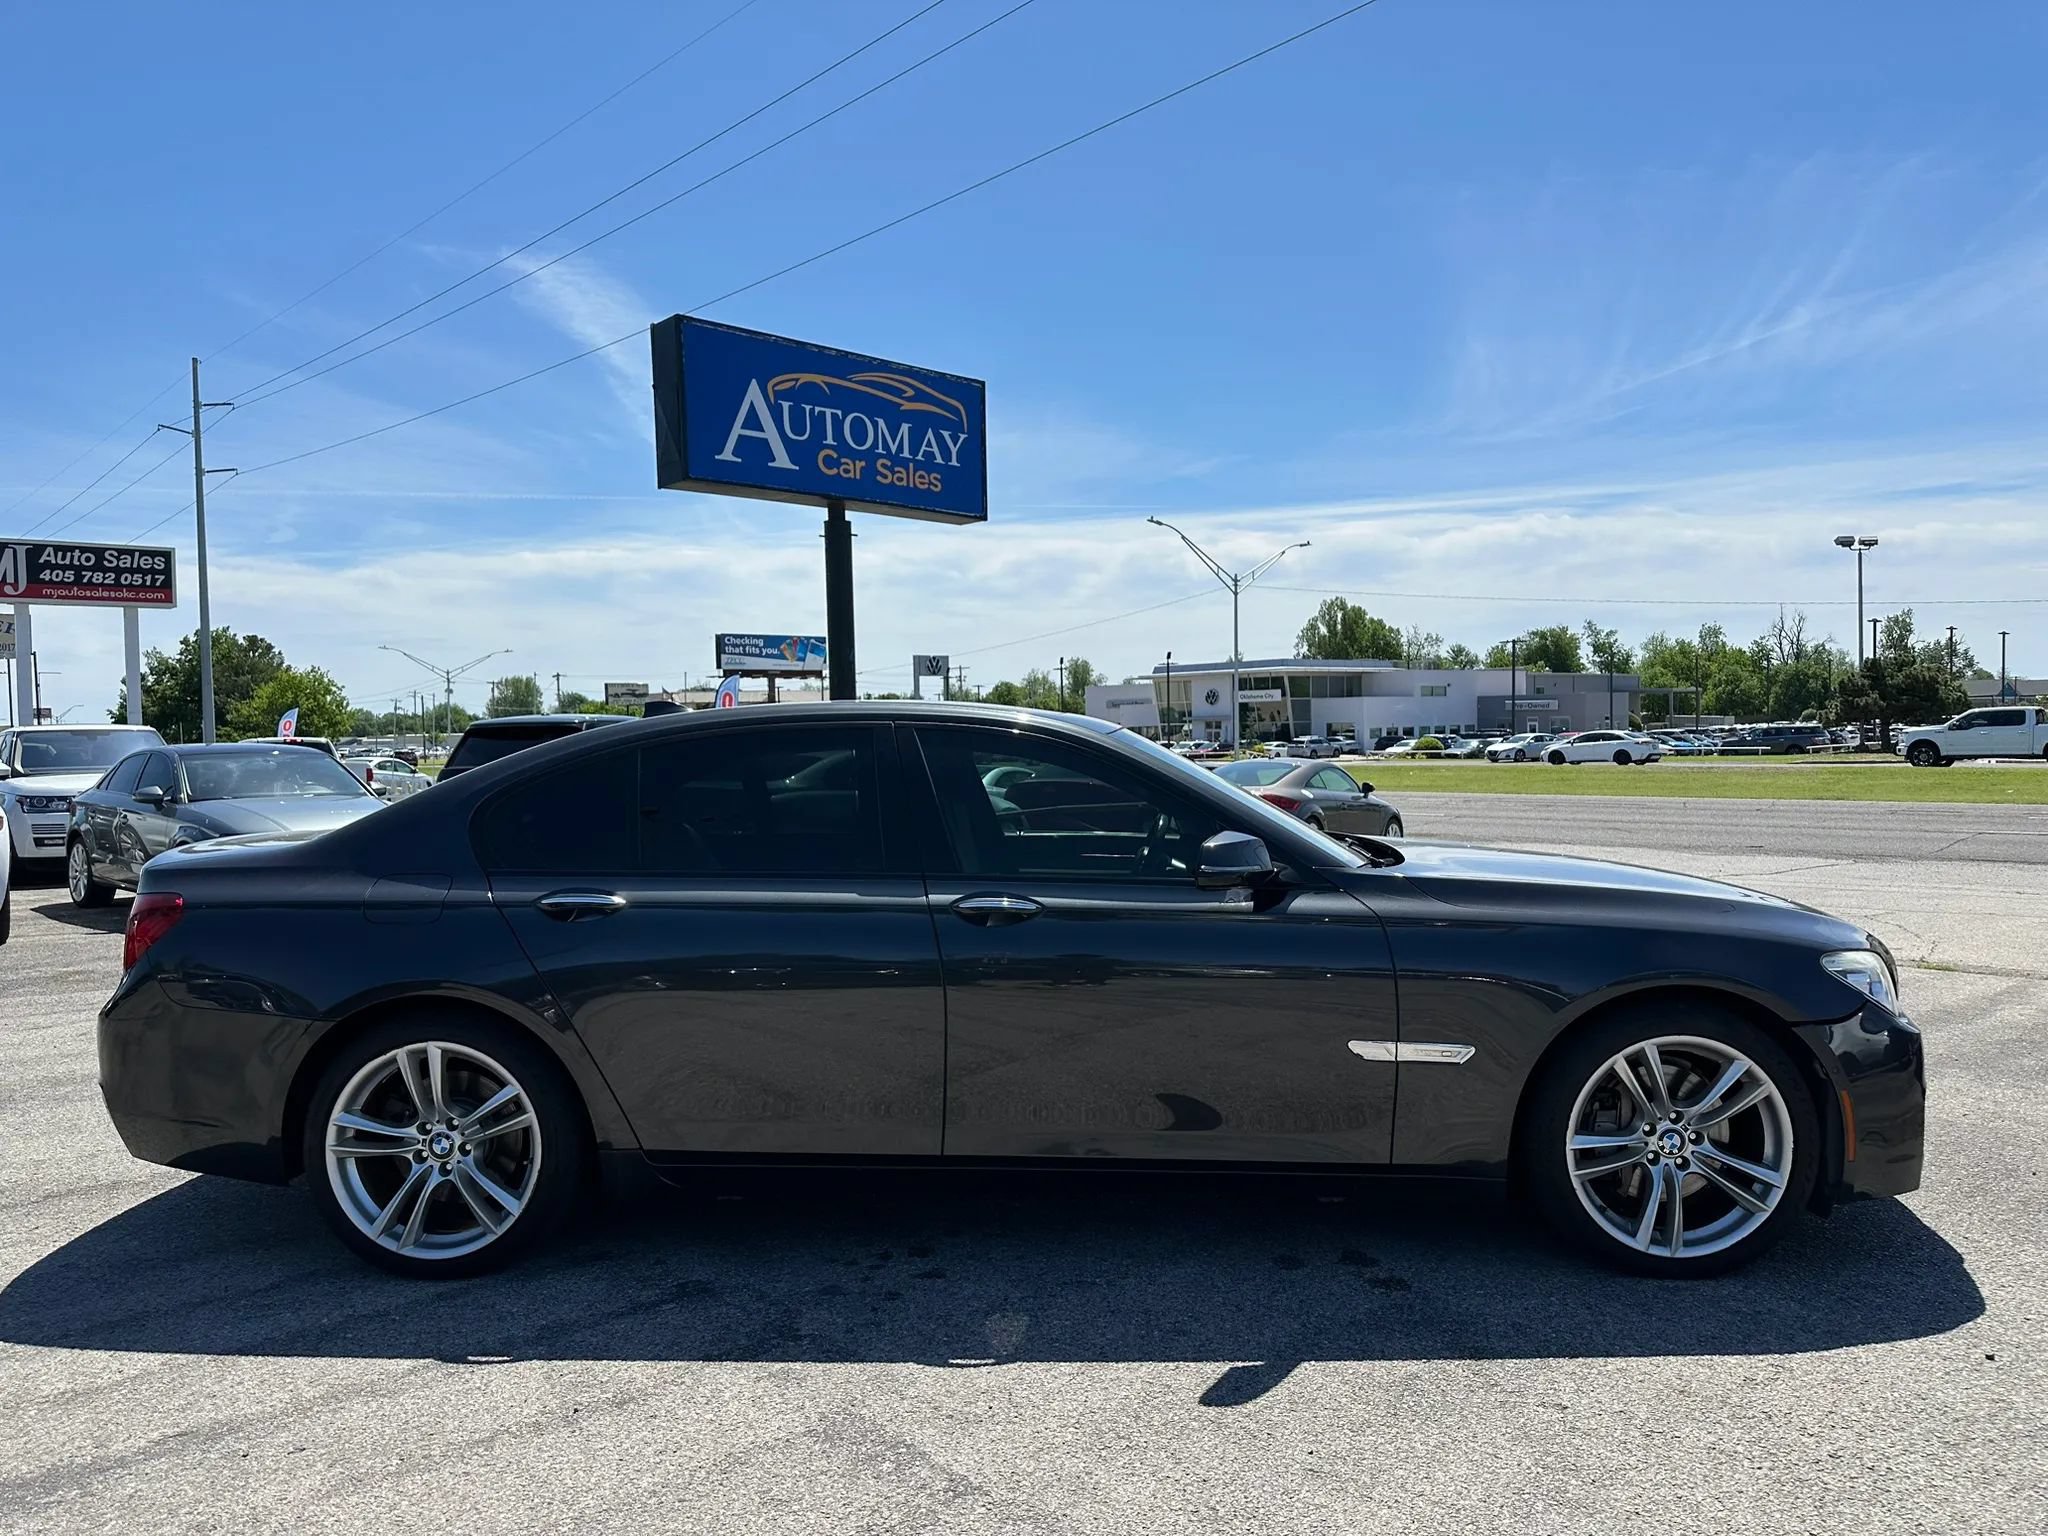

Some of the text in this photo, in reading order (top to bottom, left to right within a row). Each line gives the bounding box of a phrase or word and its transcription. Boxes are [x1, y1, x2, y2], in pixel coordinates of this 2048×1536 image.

[714, 378, 968, 470] AUTOMAY
[817, 448, 942, 493] Car Sales
[38, 547, 166, 570] Auto Sales
[39, 569, 166, 586] 405 782 0517
[42, 586, 165, 599] mjautosalesokc.com
[724, 636, 764, 646] Checking
[725, 645, 780, 656] that fits you.
